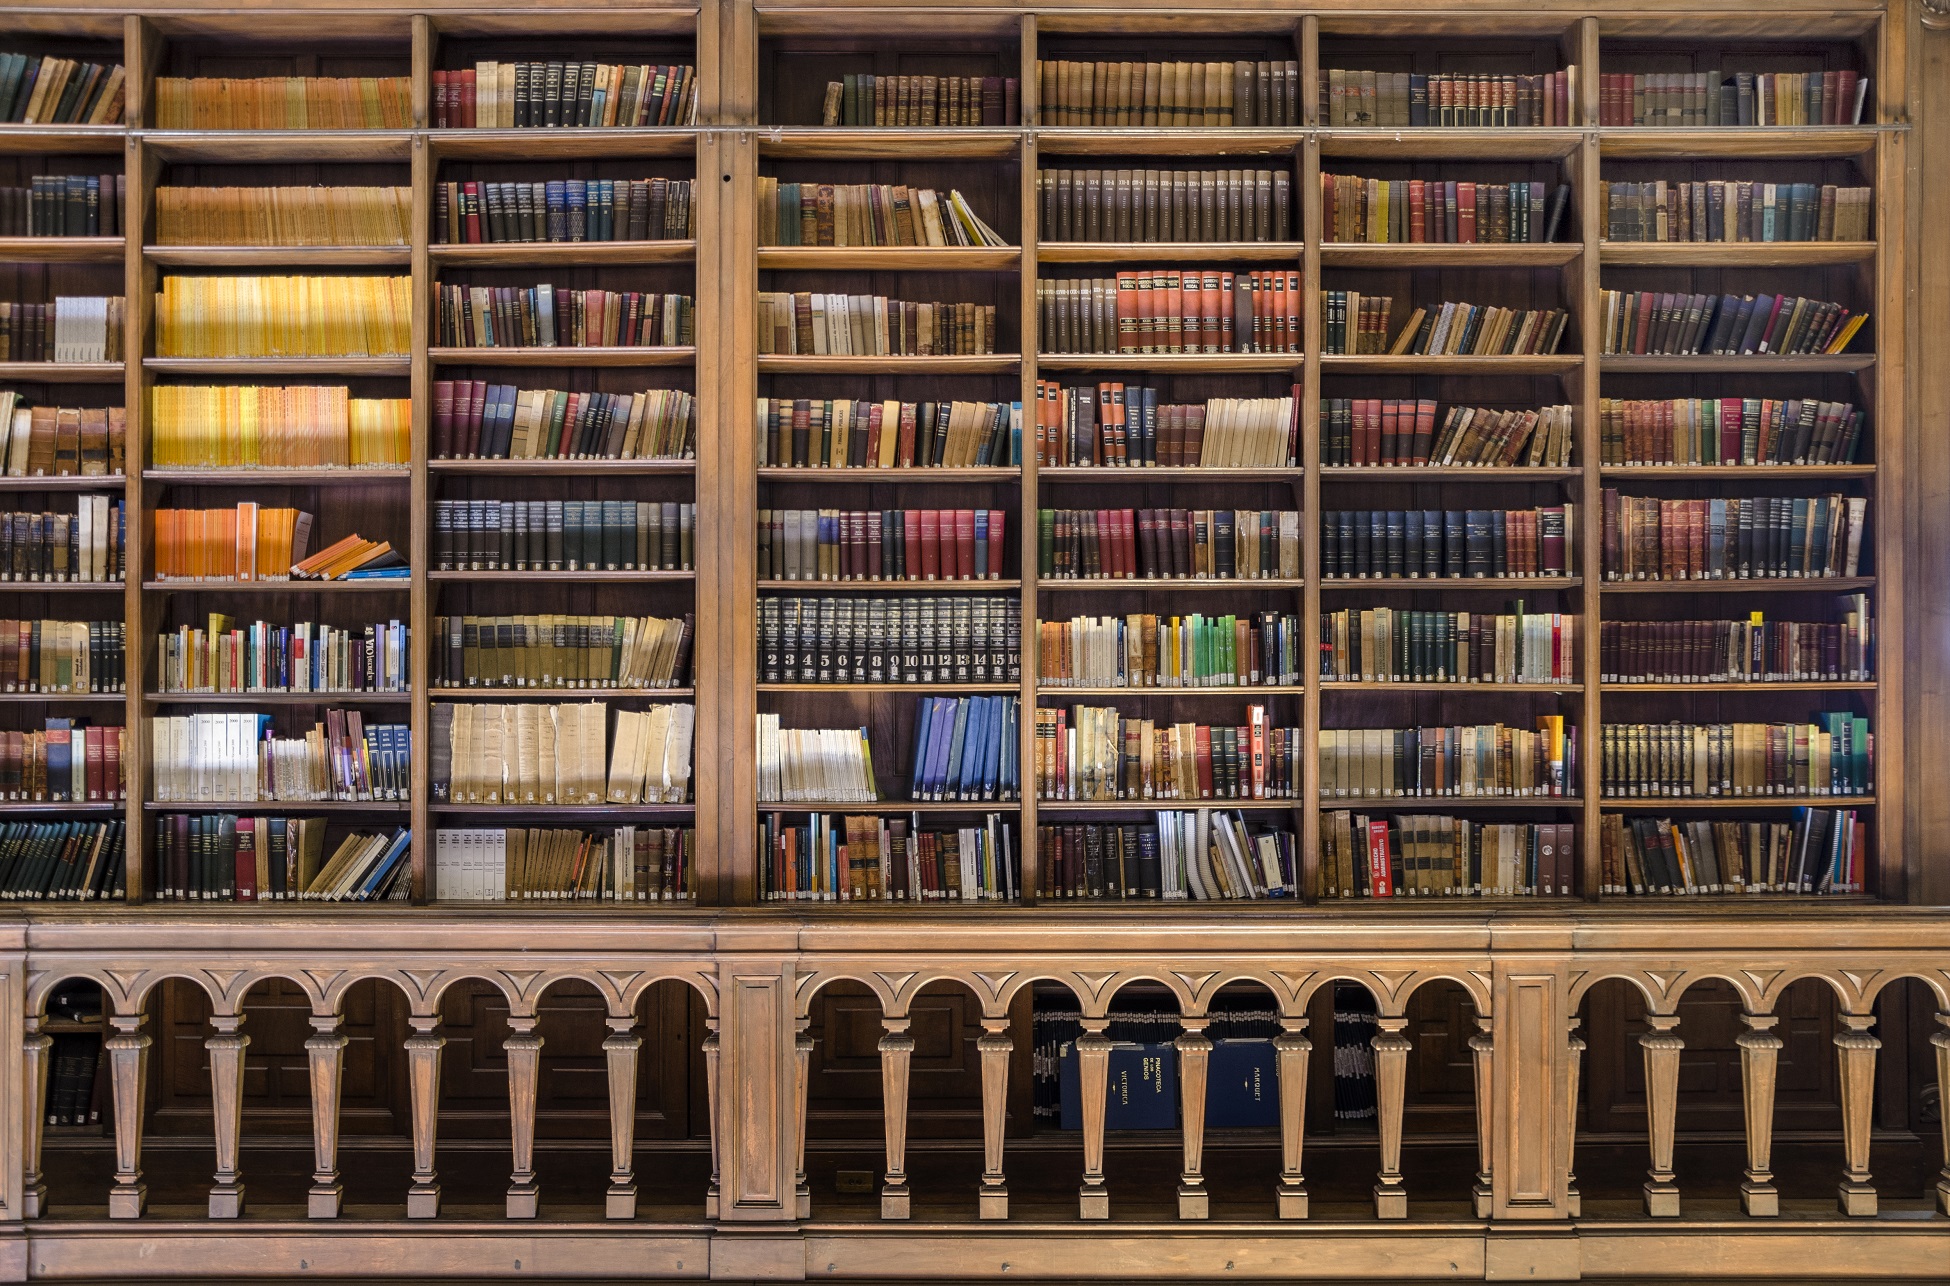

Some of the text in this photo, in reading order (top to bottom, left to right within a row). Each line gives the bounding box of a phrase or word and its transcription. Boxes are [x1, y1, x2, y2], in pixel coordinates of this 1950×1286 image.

[768, 654, 777, 665] 2
[785, 654, 795, 665] 3
[803, 654, 812, 666] 4
[821, 655, 830, 666] 5
[838, 655, 847, 666] 6
[855, 656, 864, 666] 7
[872, 656, 882, 666] 8
[891, 655, 899, 667] 9
[904, 655, 918, 667] 10
[922, 655, 934, 665] 11
[938, 655, 952, 666] 12
[956, 654, 970, 665] 13
[974, 654, 986, 665] 14
[992, 654, 1005, 665] 15
[1008, 654, 1020, 664] 16
